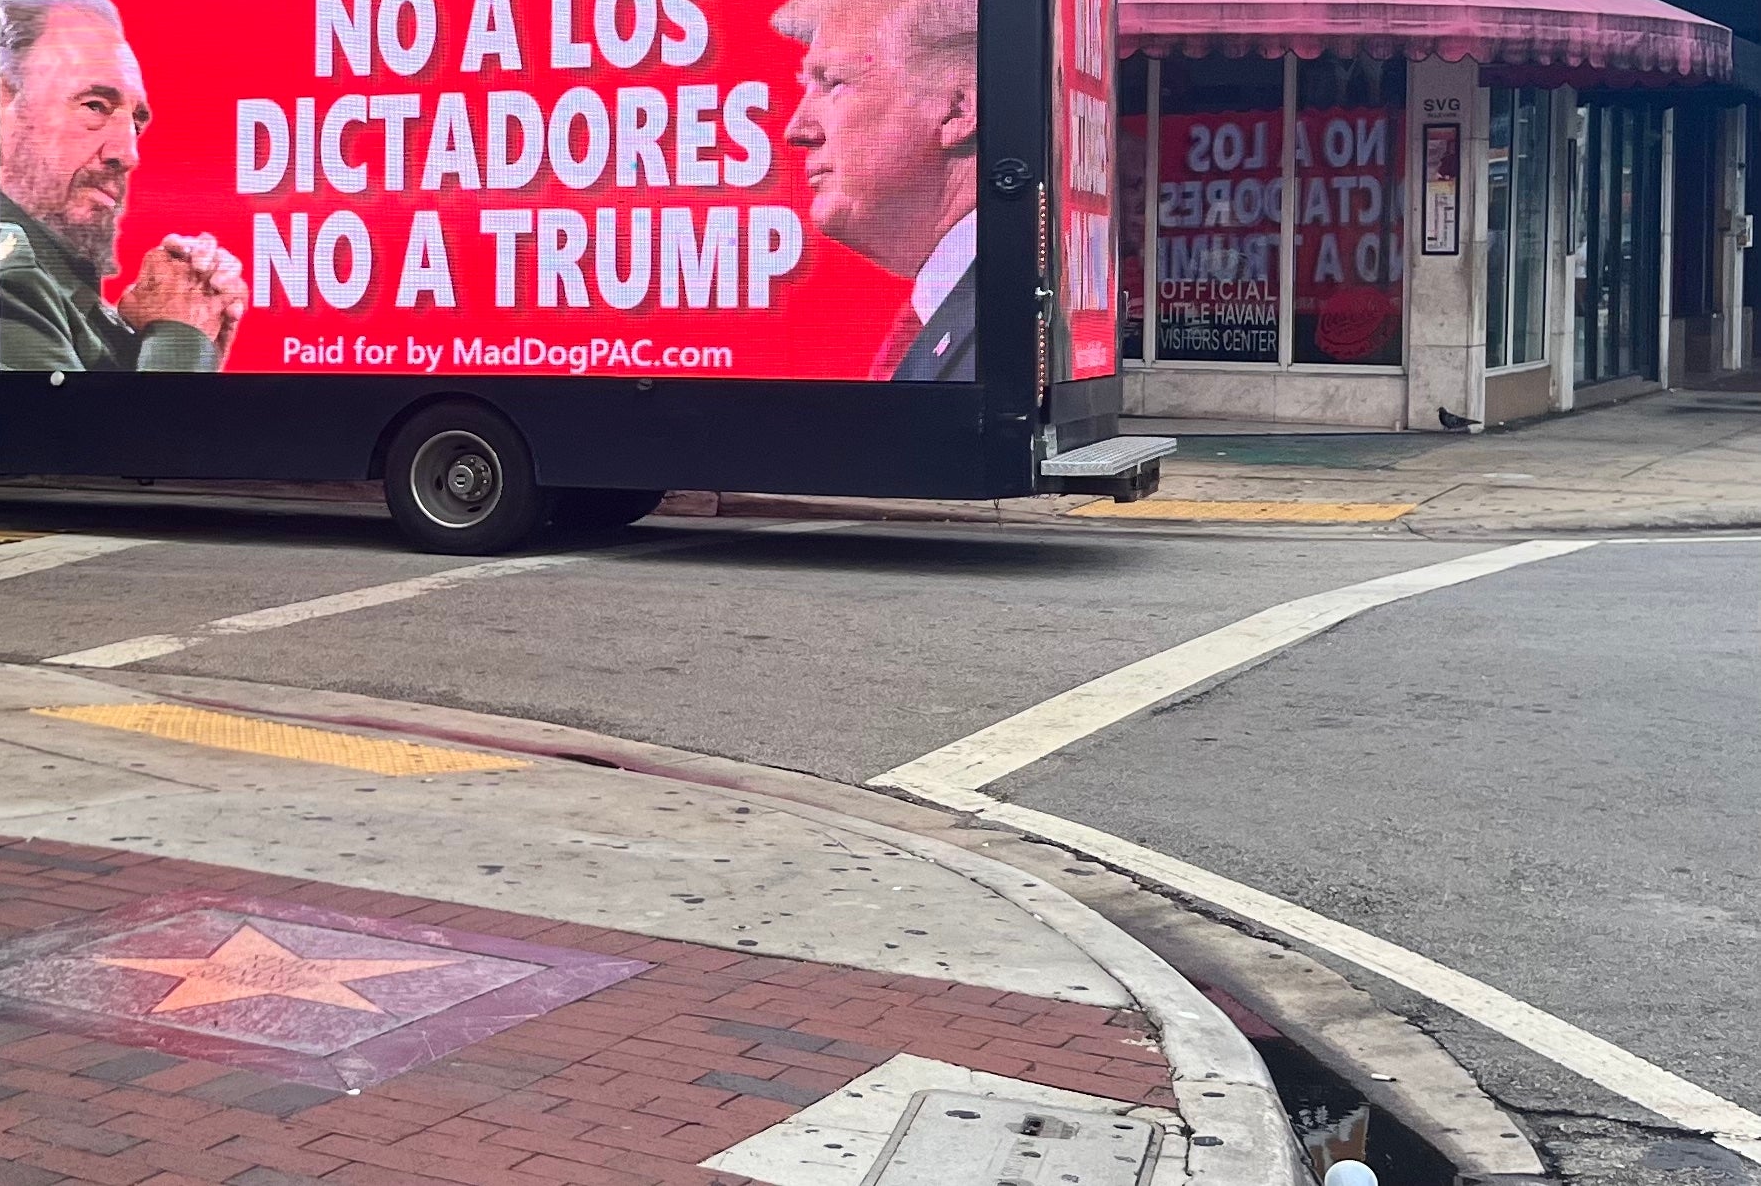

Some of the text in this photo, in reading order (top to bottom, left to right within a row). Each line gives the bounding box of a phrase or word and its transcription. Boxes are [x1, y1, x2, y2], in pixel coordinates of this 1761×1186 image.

[1423, 98, 1460, 112] SVG
[236, 80, 773, 195] DICTADORES
[252, 205, 804, 310] NO A TRUMP
[1160, 278, 1277, 301] OFFICIAL
[1160, 302, 1211, 326] LITTLE
[1214, 302, 1277, 326] HAVANA
[1160, 326, 1277, 353] VISITORS CENTER
[283, 335, 734, 376] Paid for by MadDogPAC.com
